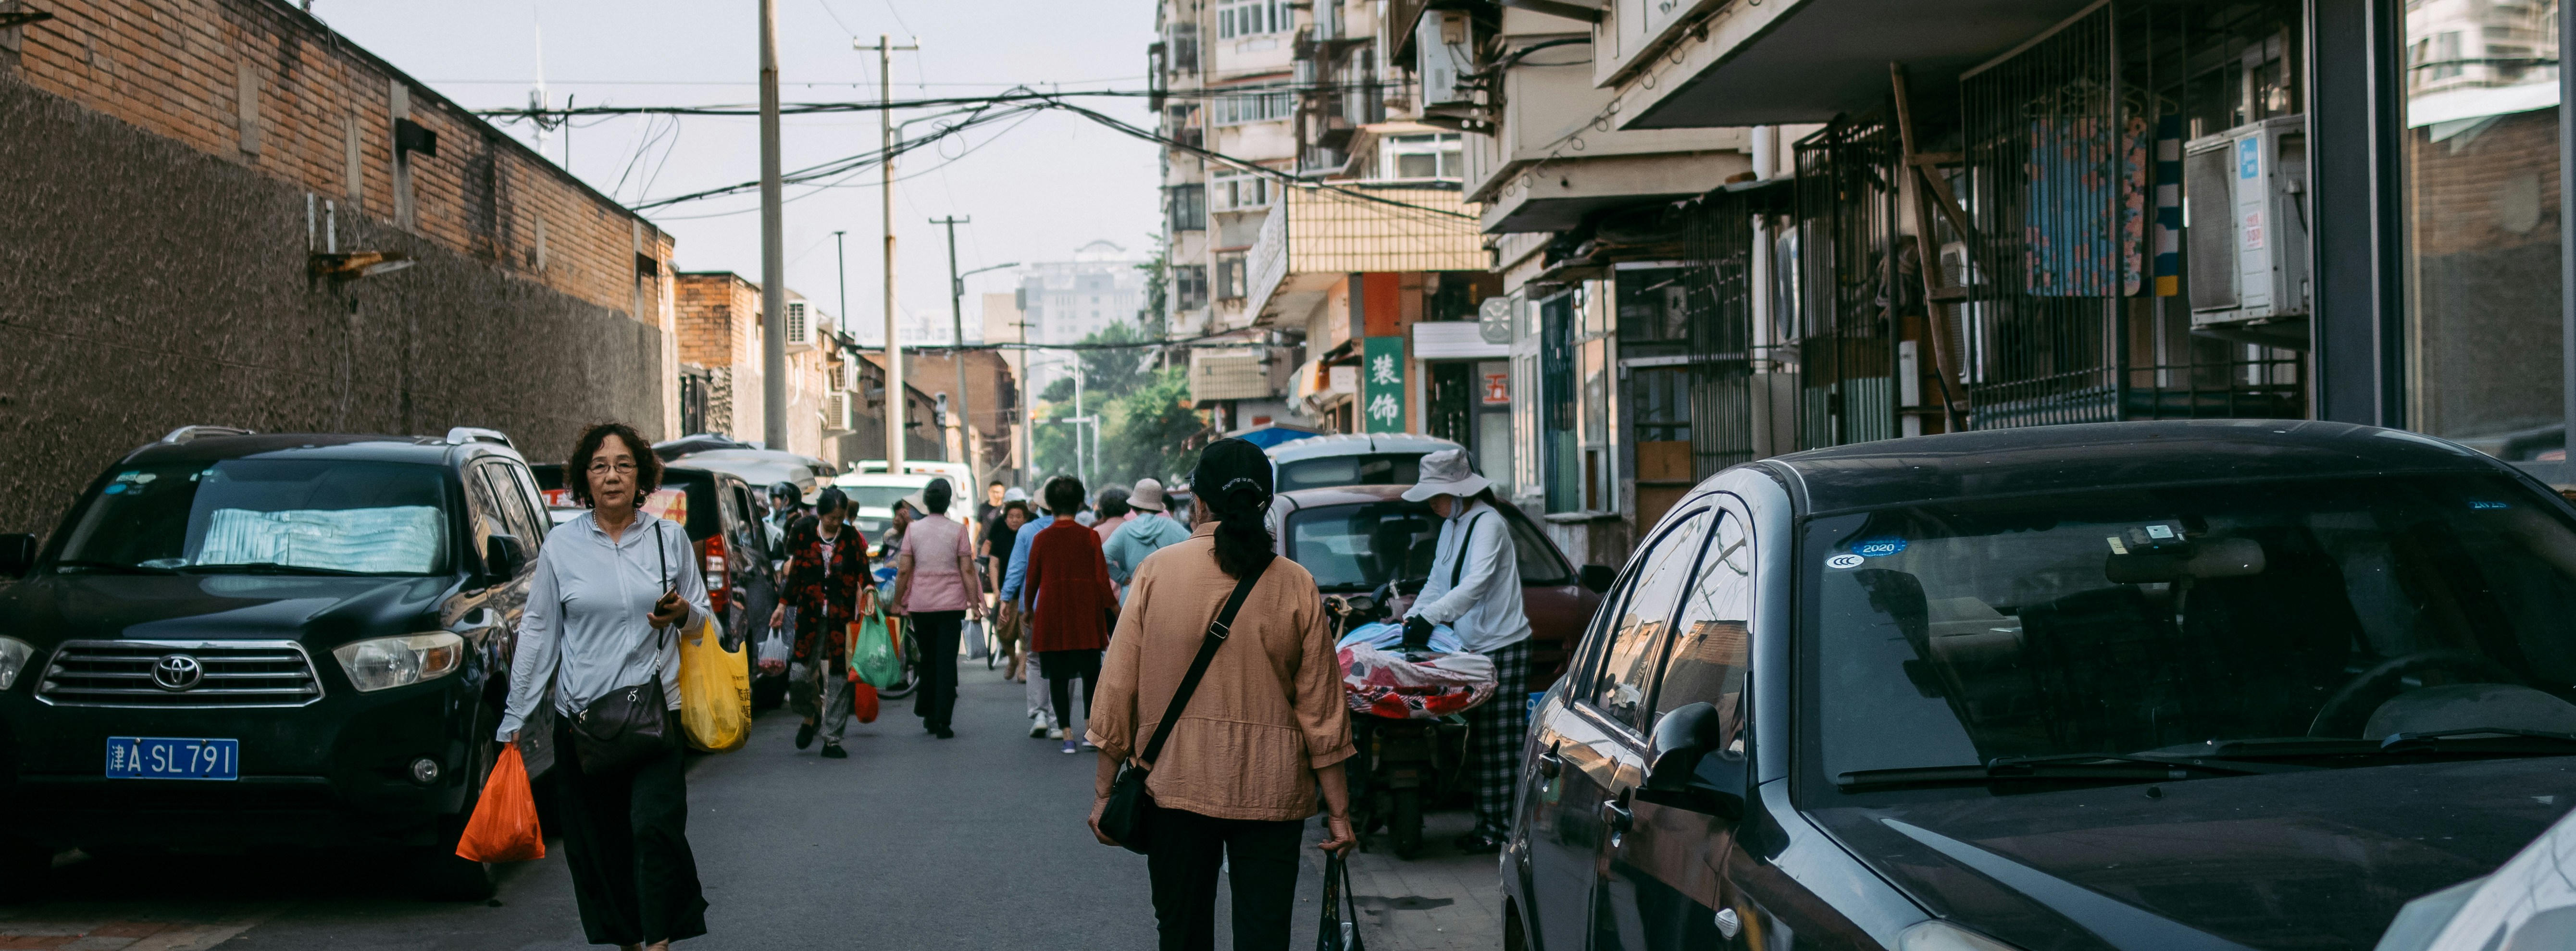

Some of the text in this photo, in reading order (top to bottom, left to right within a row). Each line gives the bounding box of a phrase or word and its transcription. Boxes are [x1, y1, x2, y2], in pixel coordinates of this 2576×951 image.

[1368, 353, 1400, 427] 装饰
[1863, 543, 1895, 553] 2020
[1833, 556, 1855, 566] CCC
